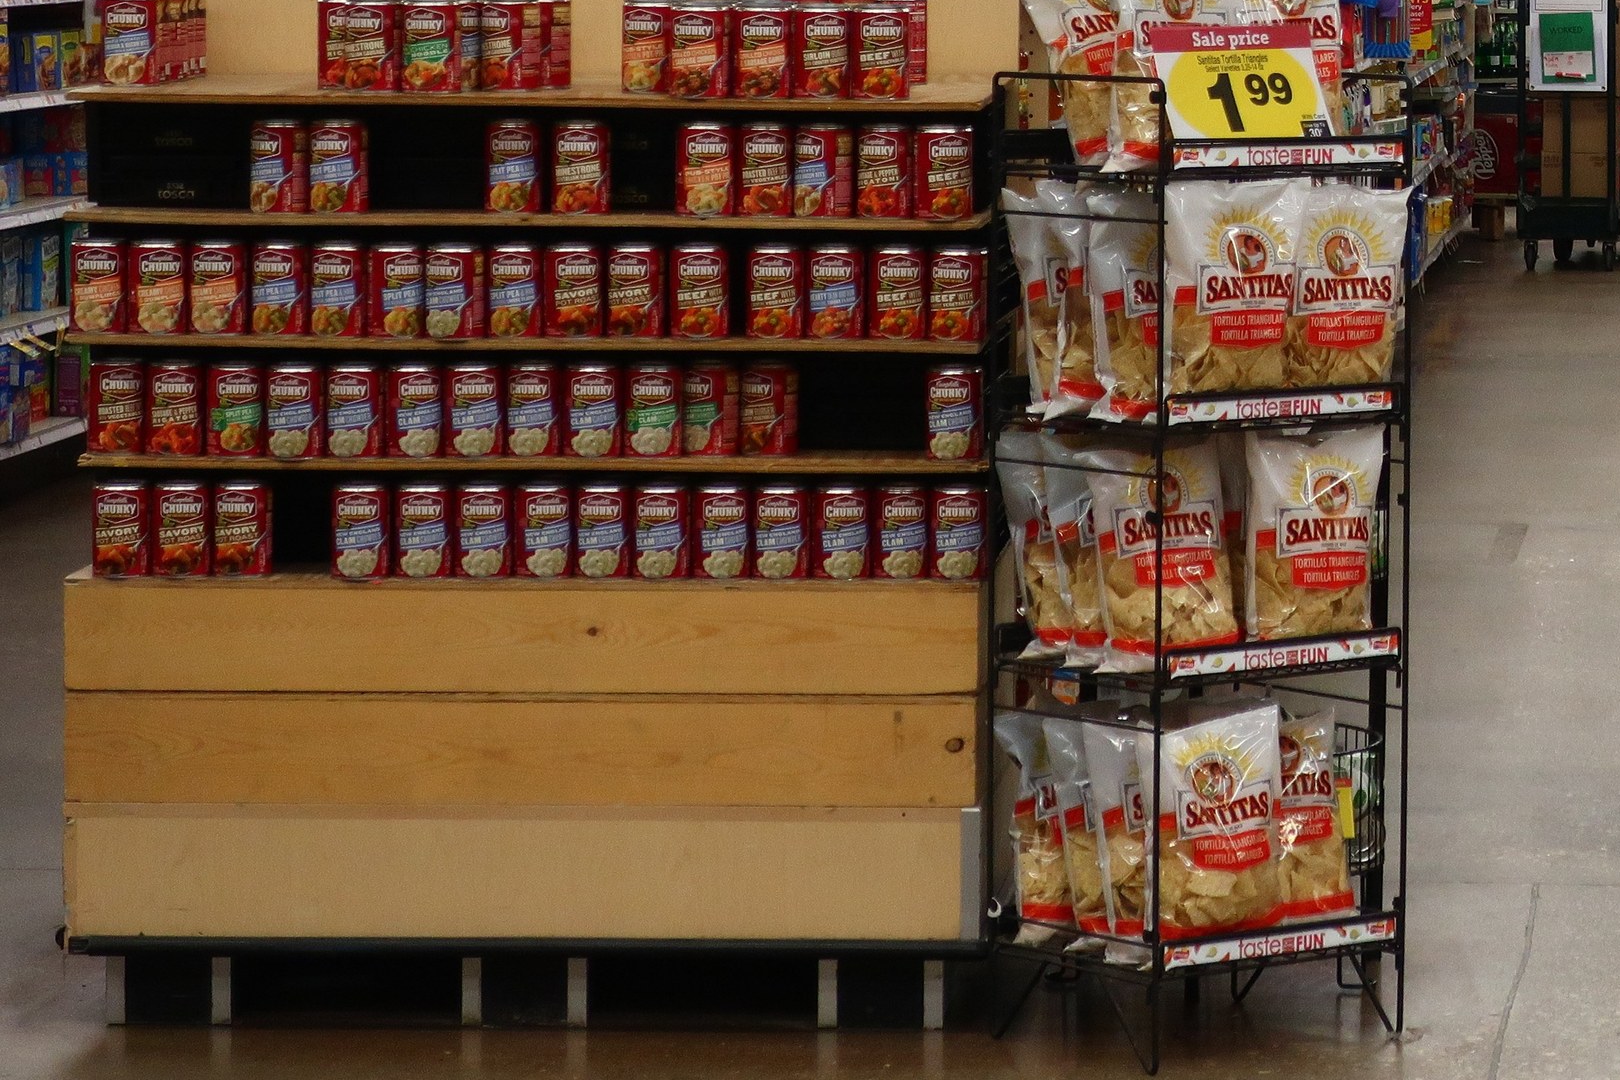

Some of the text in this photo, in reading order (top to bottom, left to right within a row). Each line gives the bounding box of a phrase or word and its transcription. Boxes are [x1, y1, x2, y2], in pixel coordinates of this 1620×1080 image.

[1192, 31, 1269, 49] Sale price
[860, 51, 891, 63] BEEF
[1197, 54, 1268, 64] Santitas Tortilla Triangles
[1248, 147, 1333, 165] taste FUN
[1206, 273, 1293, 302] SANTITAS
[1303, 275, 1392, 304] SANTITAS
